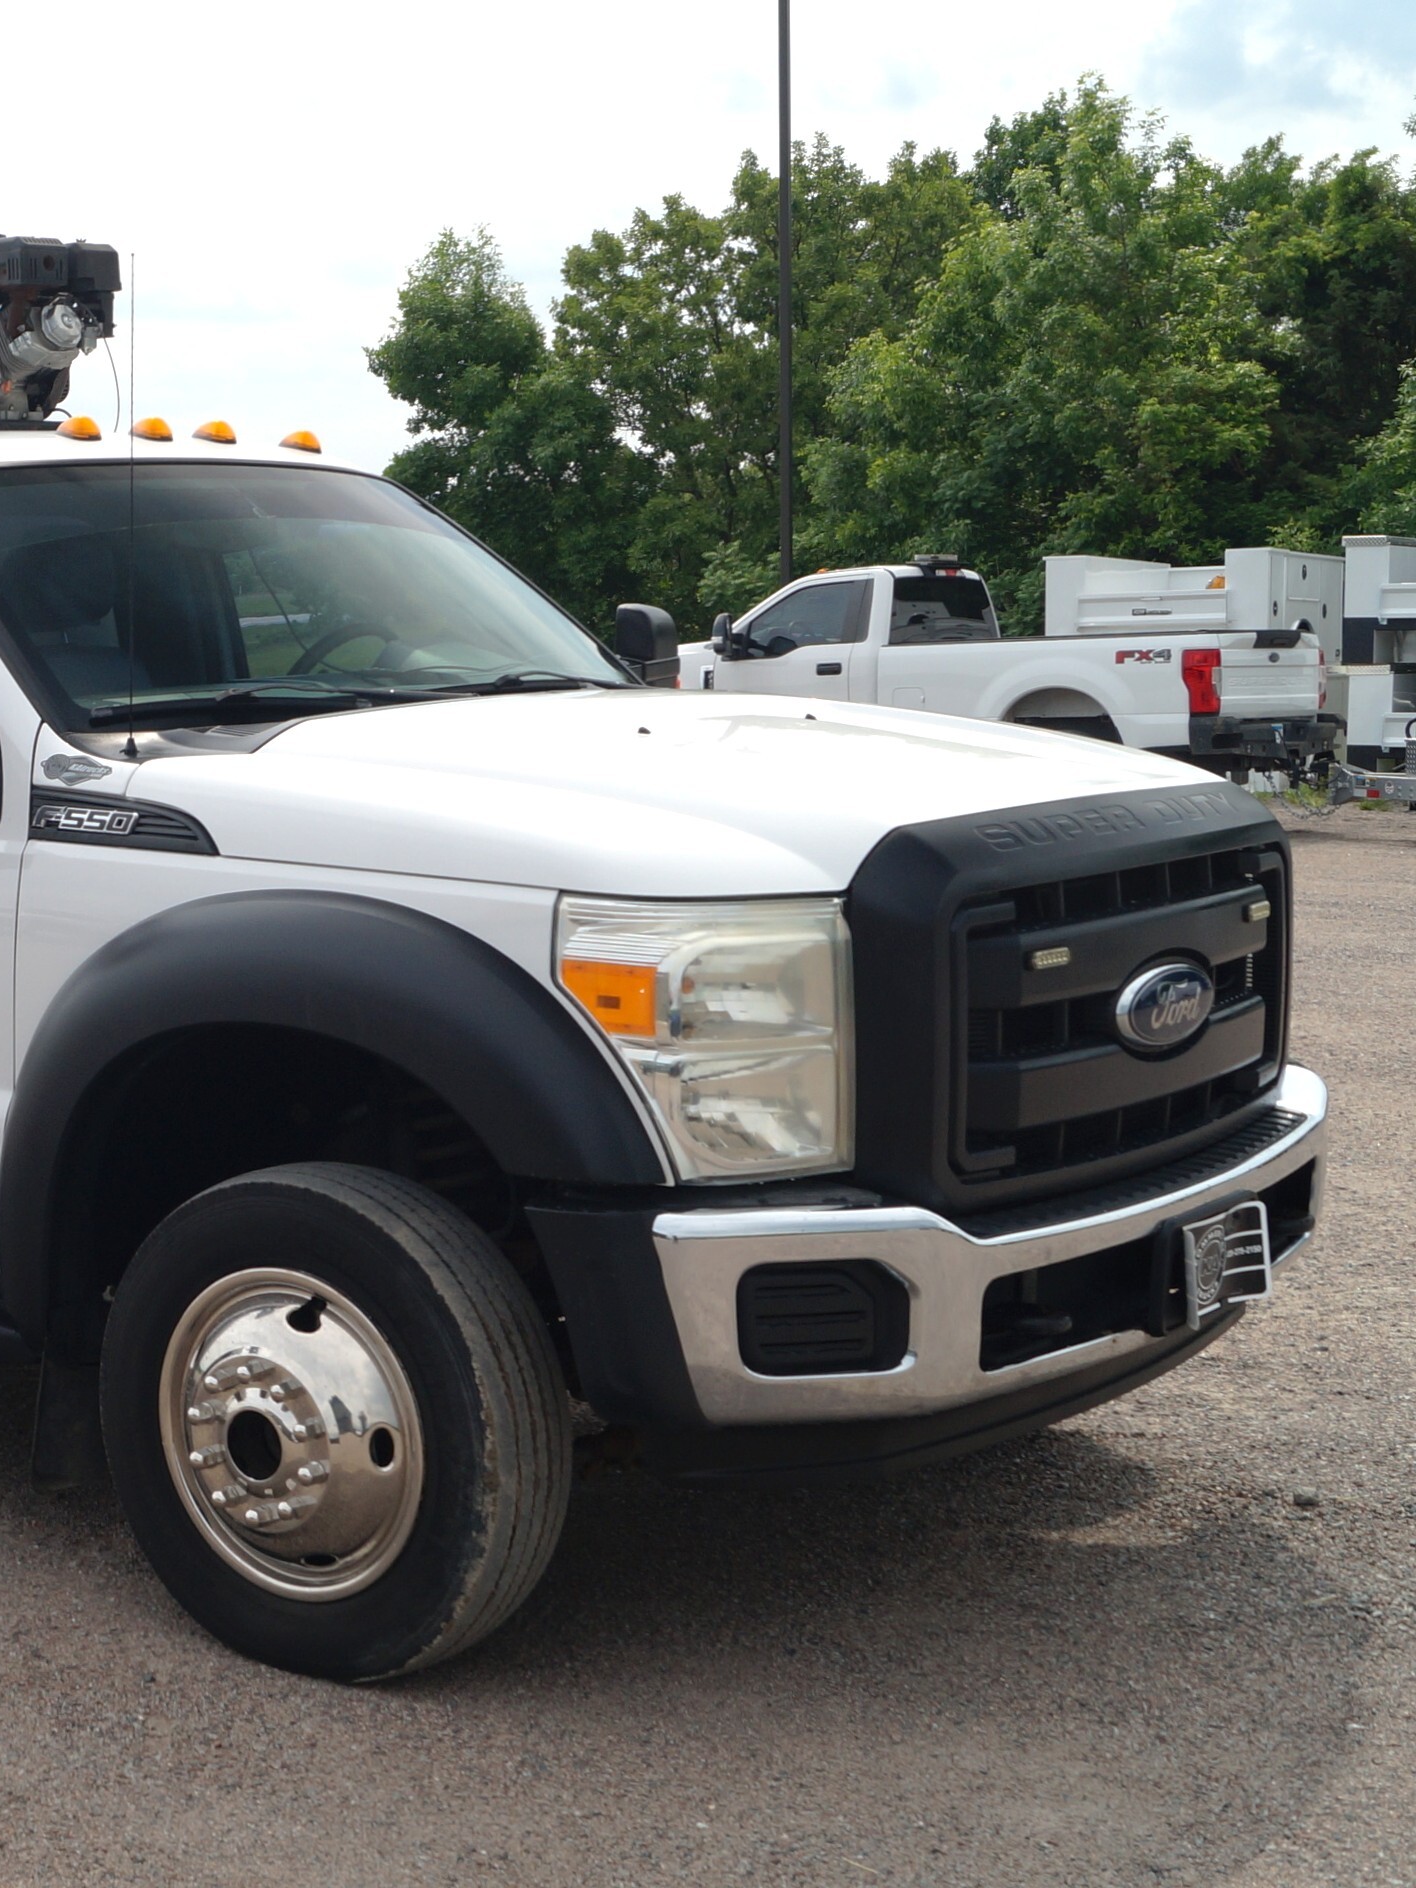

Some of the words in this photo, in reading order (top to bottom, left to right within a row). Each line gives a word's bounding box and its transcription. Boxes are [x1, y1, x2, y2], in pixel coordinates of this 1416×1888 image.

[1114, 648, 1172, 664] FX4
[31, 804, 140, 836] F-550
[973, 804, 1146, 853] SUPER
[1142, 792, 1239, 826] DUTY
[1149, 980, 1203, 1032] Ford
